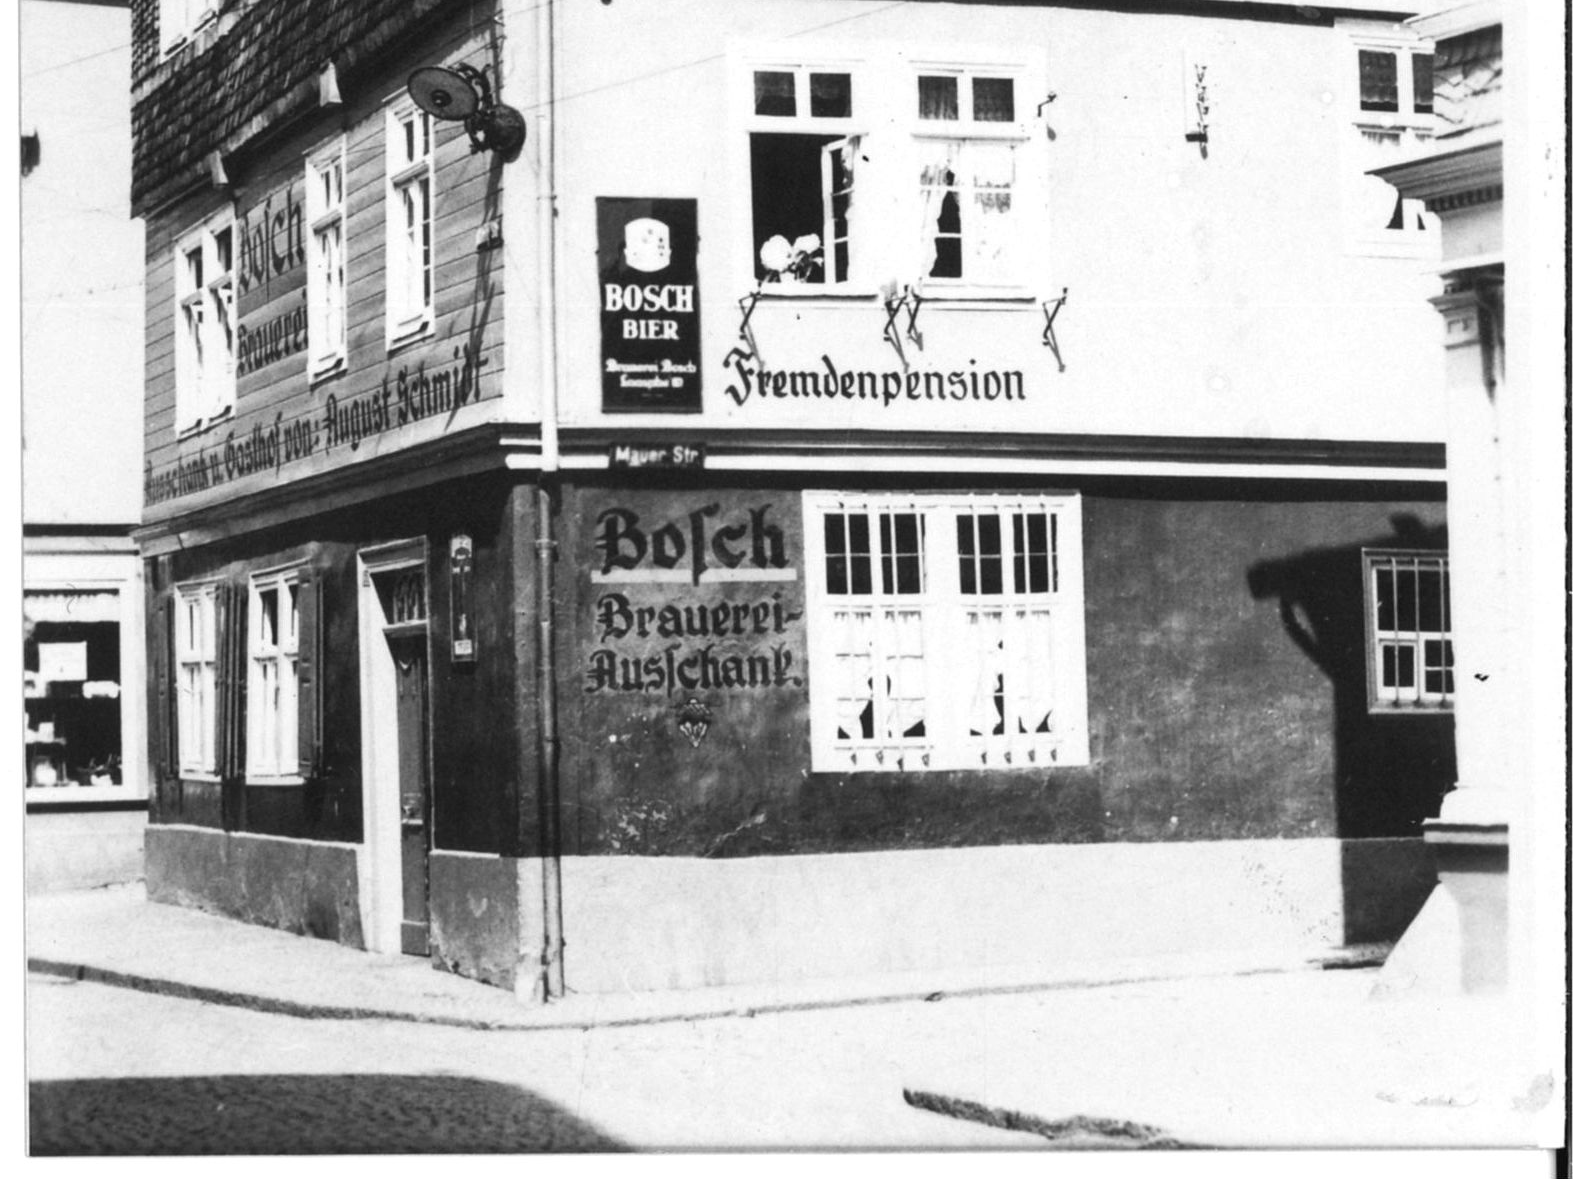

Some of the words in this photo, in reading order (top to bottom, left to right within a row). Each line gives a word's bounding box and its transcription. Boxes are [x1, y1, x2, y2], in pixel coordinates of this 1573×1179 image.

[605, 284, 694, 312] BOSCH
[623, 319, 679, 340] BIER
[723, 347, 1026, 407] Fremdenpension
[323, 373, 390, 455] August
[398, 344, 488, 424] Schmidt
[615, 446, 667, 467] Mauer
[597, 592, 804, 643] Brauerei-
